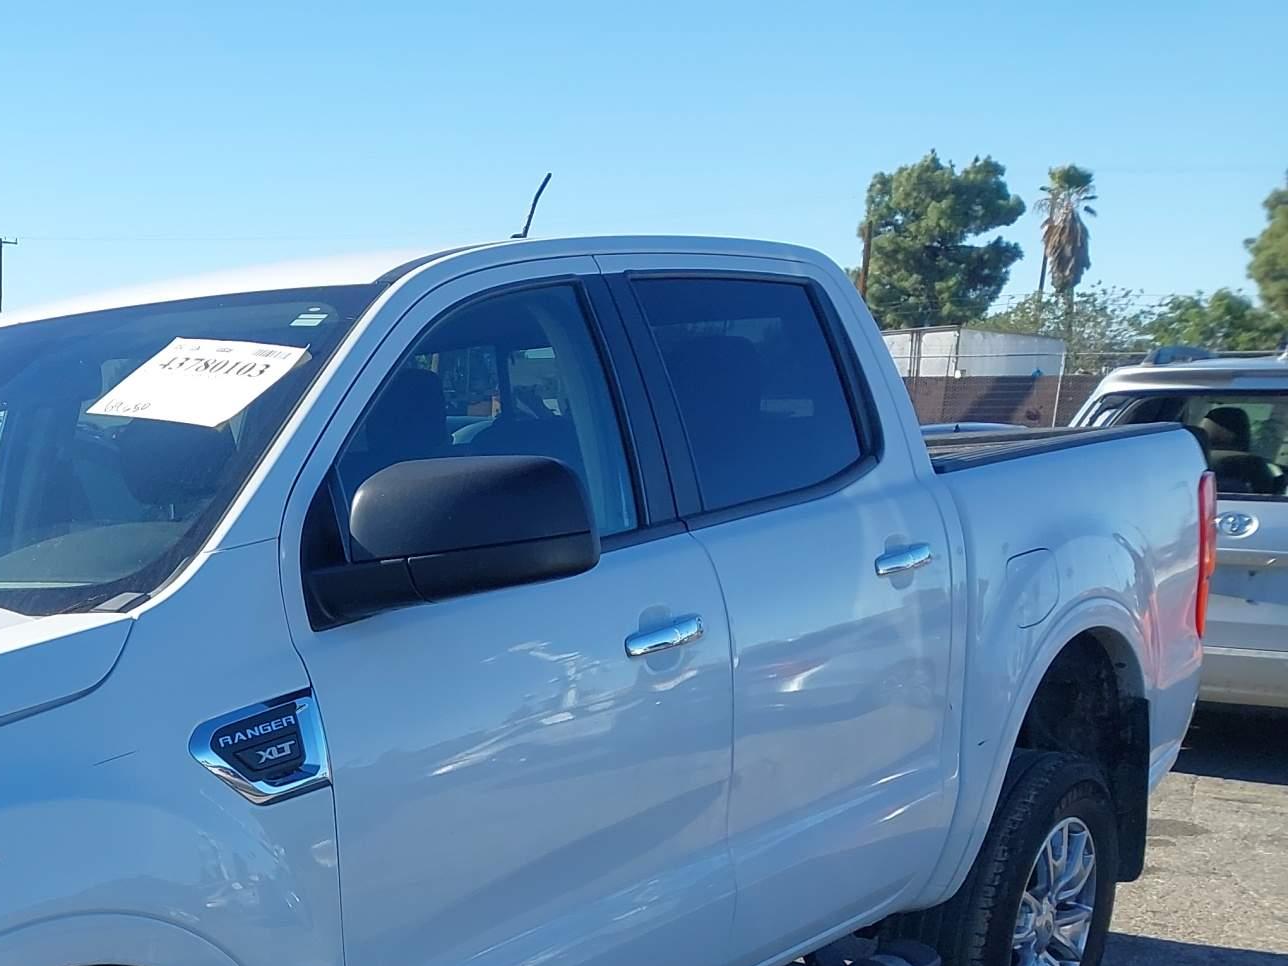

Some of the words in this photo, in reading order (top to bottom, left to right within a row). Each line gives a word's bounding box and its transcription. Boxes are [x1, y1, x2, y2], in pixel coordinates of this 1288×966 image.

[159, 356, 271, 378] 43780103
[218, 715, 296, 748] RANGER
[255, 740, 296, 764] XLT
